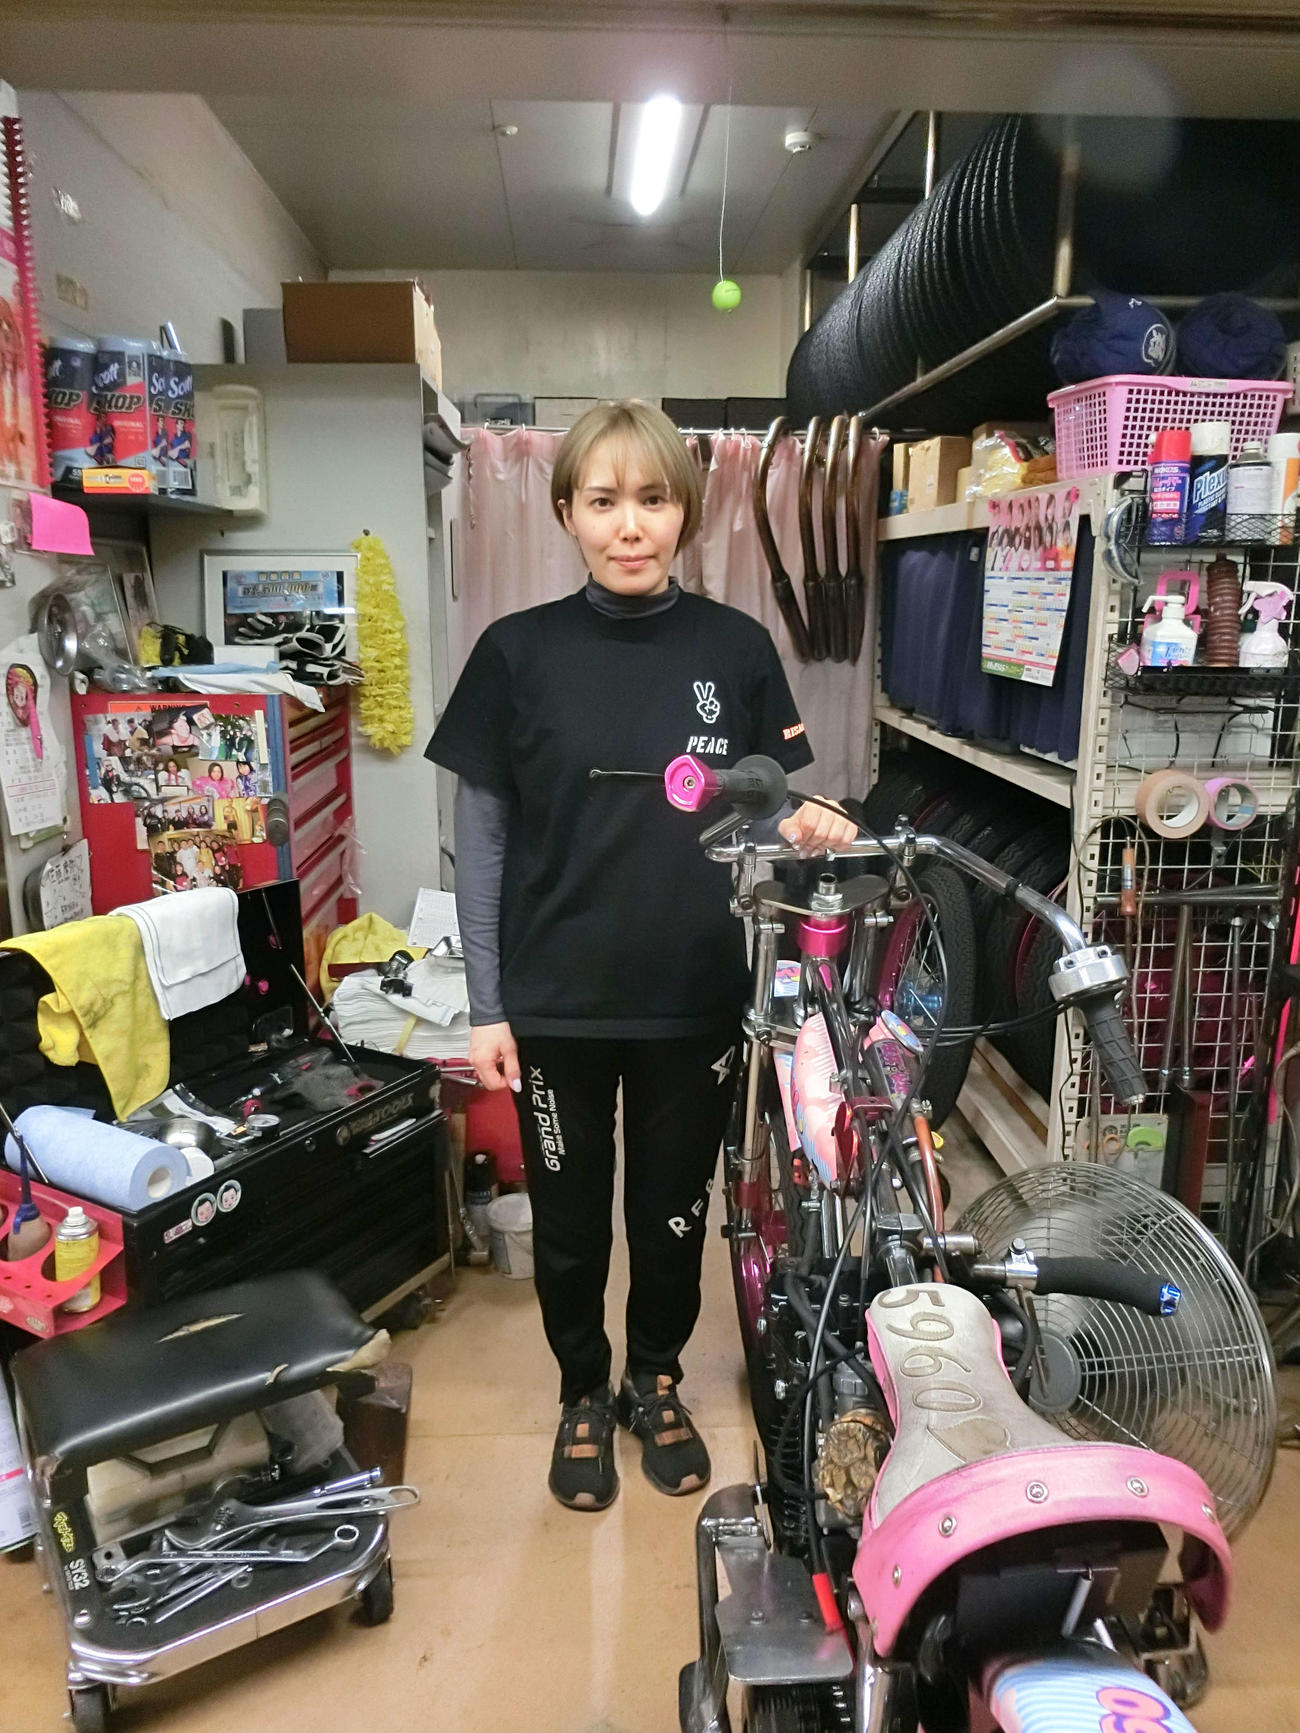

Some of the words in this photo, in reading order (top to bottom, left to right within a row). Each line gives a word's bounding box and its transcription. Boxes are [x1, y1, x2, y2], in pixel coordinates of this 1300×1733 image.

[686, 736, 729, 755] PEACE
[528, 1065, 548, 1109] Prix
[547, 1089, 557, 1112] Noise
[551, 1112, 561, 1134] Some
[533, 1111, 561, 1171] Grand
[877, 1289, 982, 1413] 5960
[69, 1558, 90, 1591] SY32
